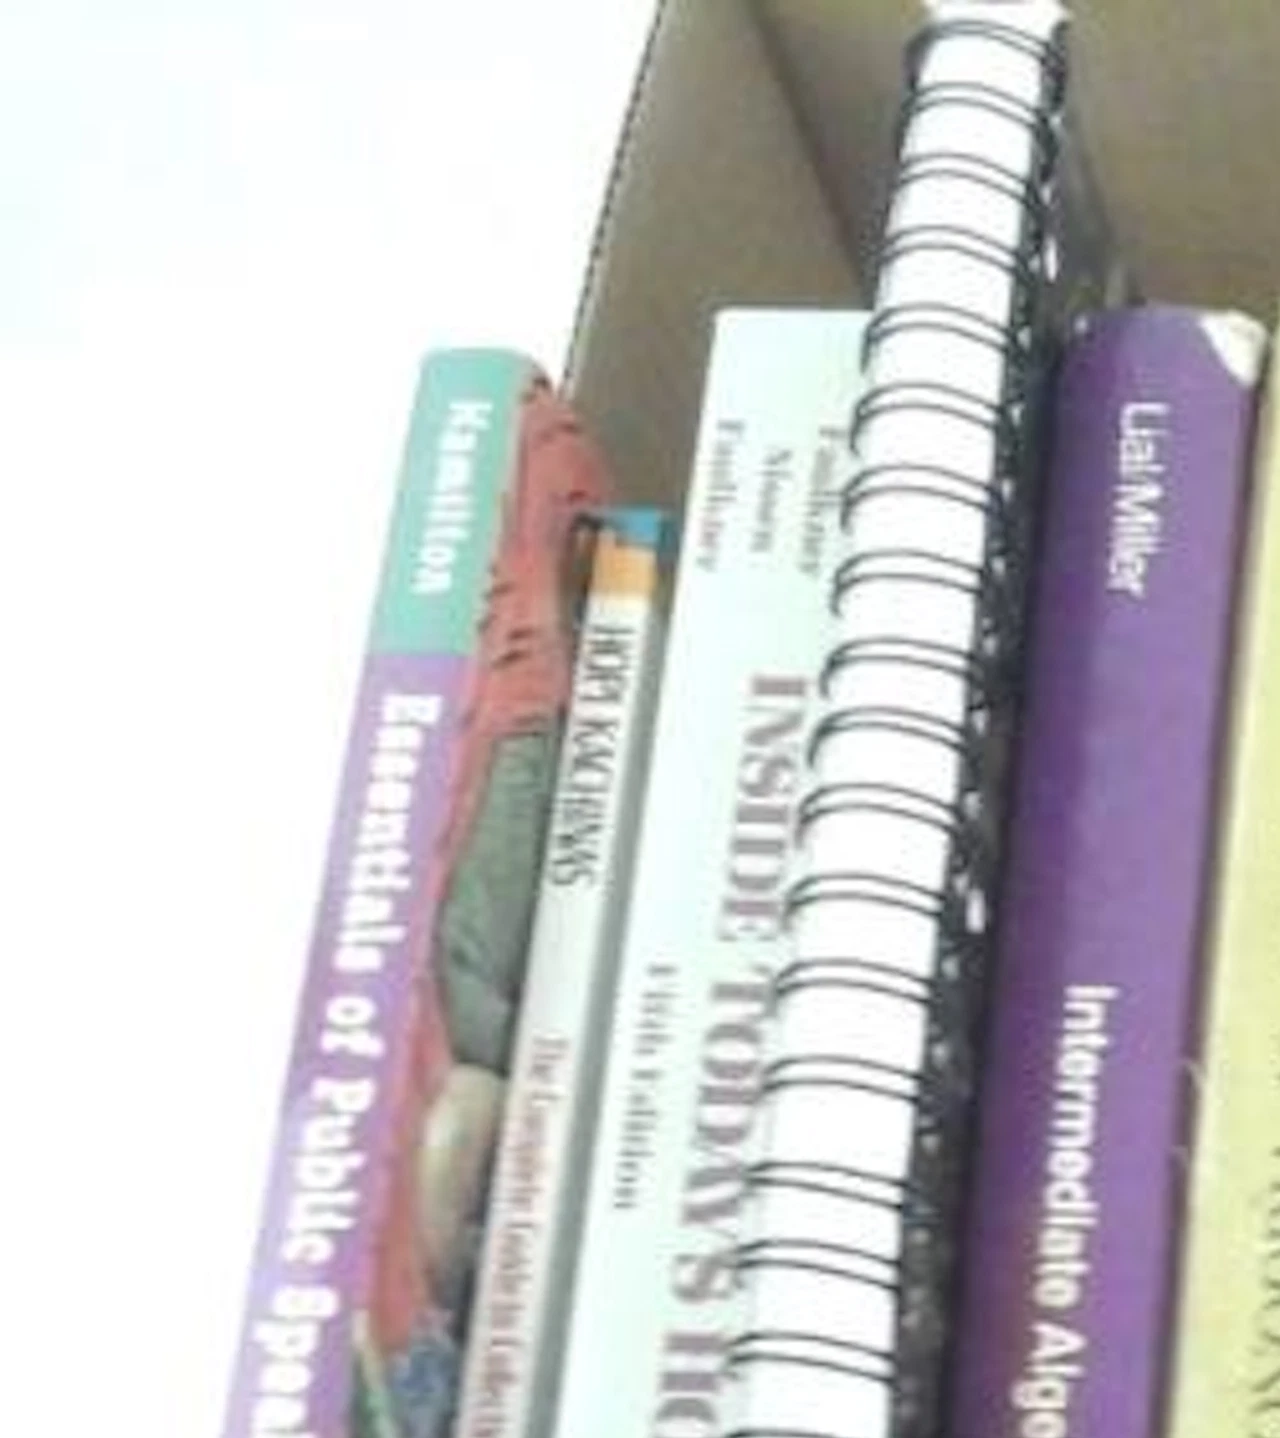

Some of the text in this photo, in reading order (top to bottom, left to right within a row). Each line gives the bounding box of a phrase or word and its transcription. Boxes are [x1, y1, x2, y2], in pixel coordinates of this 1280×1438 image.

[412, 399, 492, 594] Hamilton
[694, 419, 745, 572] Faulkner
[332, 693, 442, 973] Essentials
[547, 623, 637, 889] HOPI KACHINAS
[717, 672, 810, 942] INSIDE
[322, 995, 384, 1055] of
[281, 1077, 373, 1262] Public
[612, 1068, 668, 1211] Edition
[1033, 984, 1118, 1308] Intermediate
